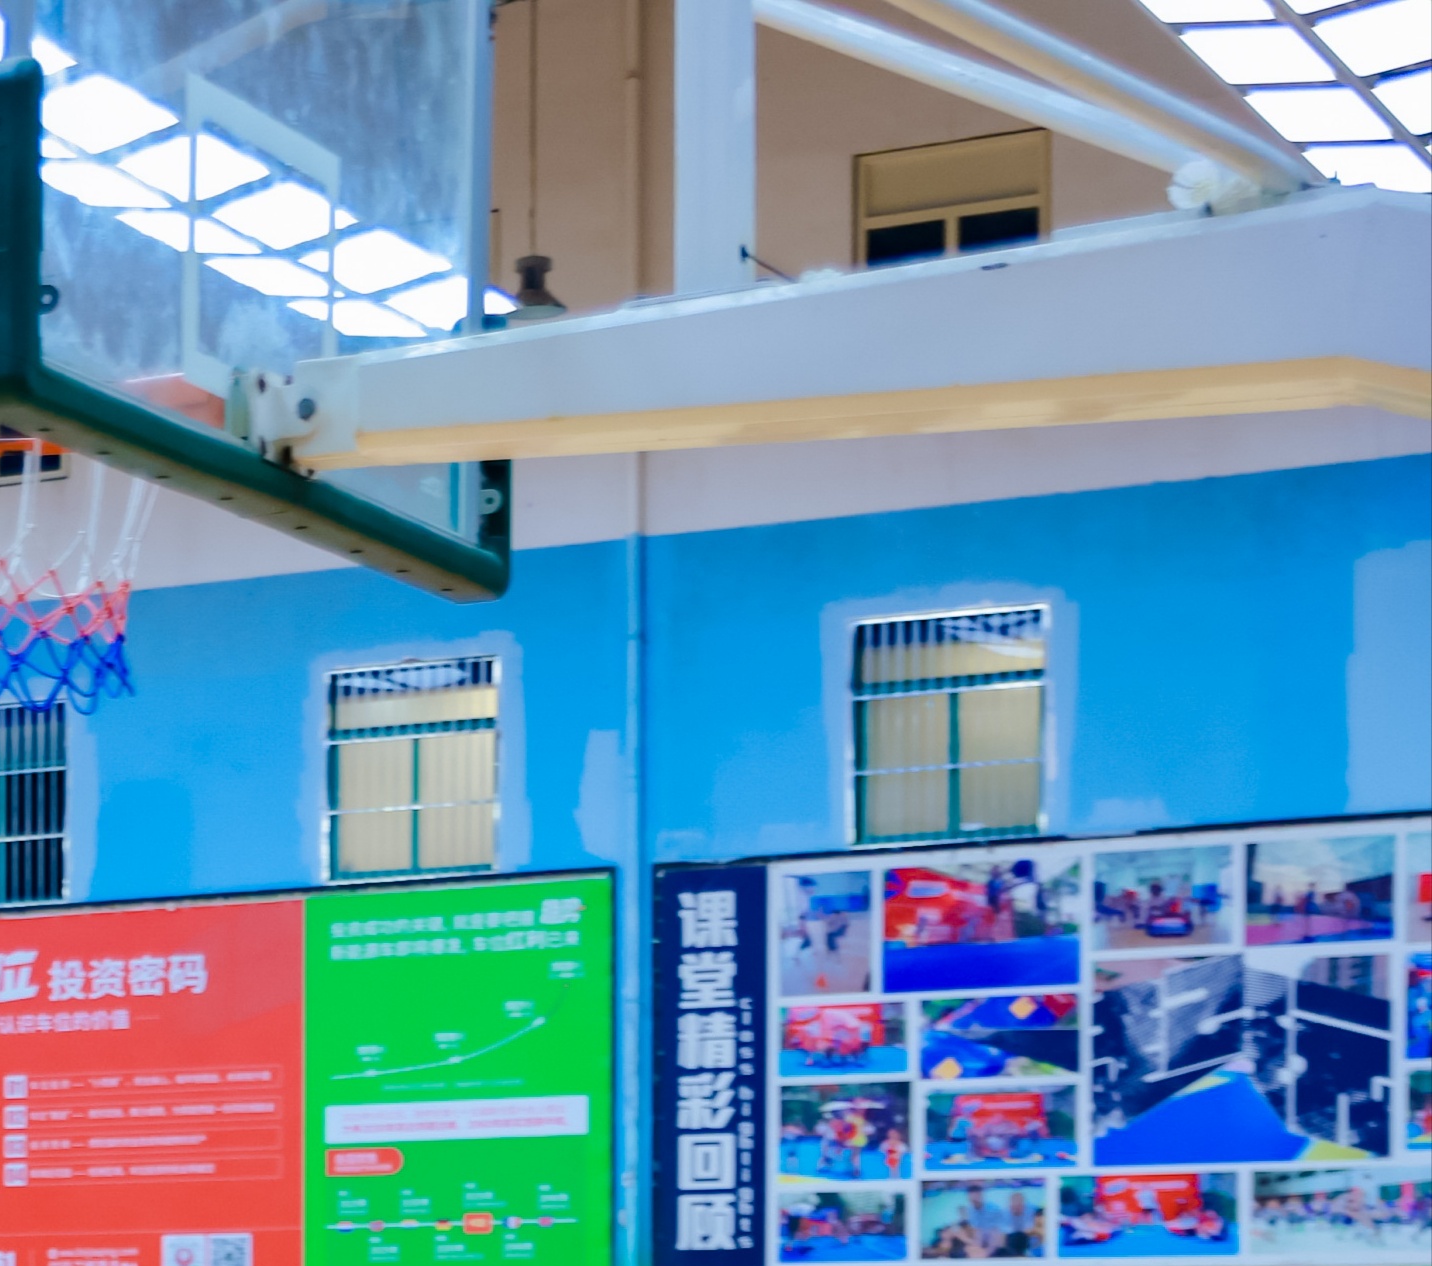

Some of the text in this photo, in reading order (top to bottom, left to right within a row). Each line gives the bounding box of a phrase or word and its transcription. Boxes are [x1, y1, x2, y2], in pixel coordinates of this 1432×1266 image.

[47, 953, 209, 1003] 投资密码
[676, 890, 737, 1251] 课堂精彩回顾
